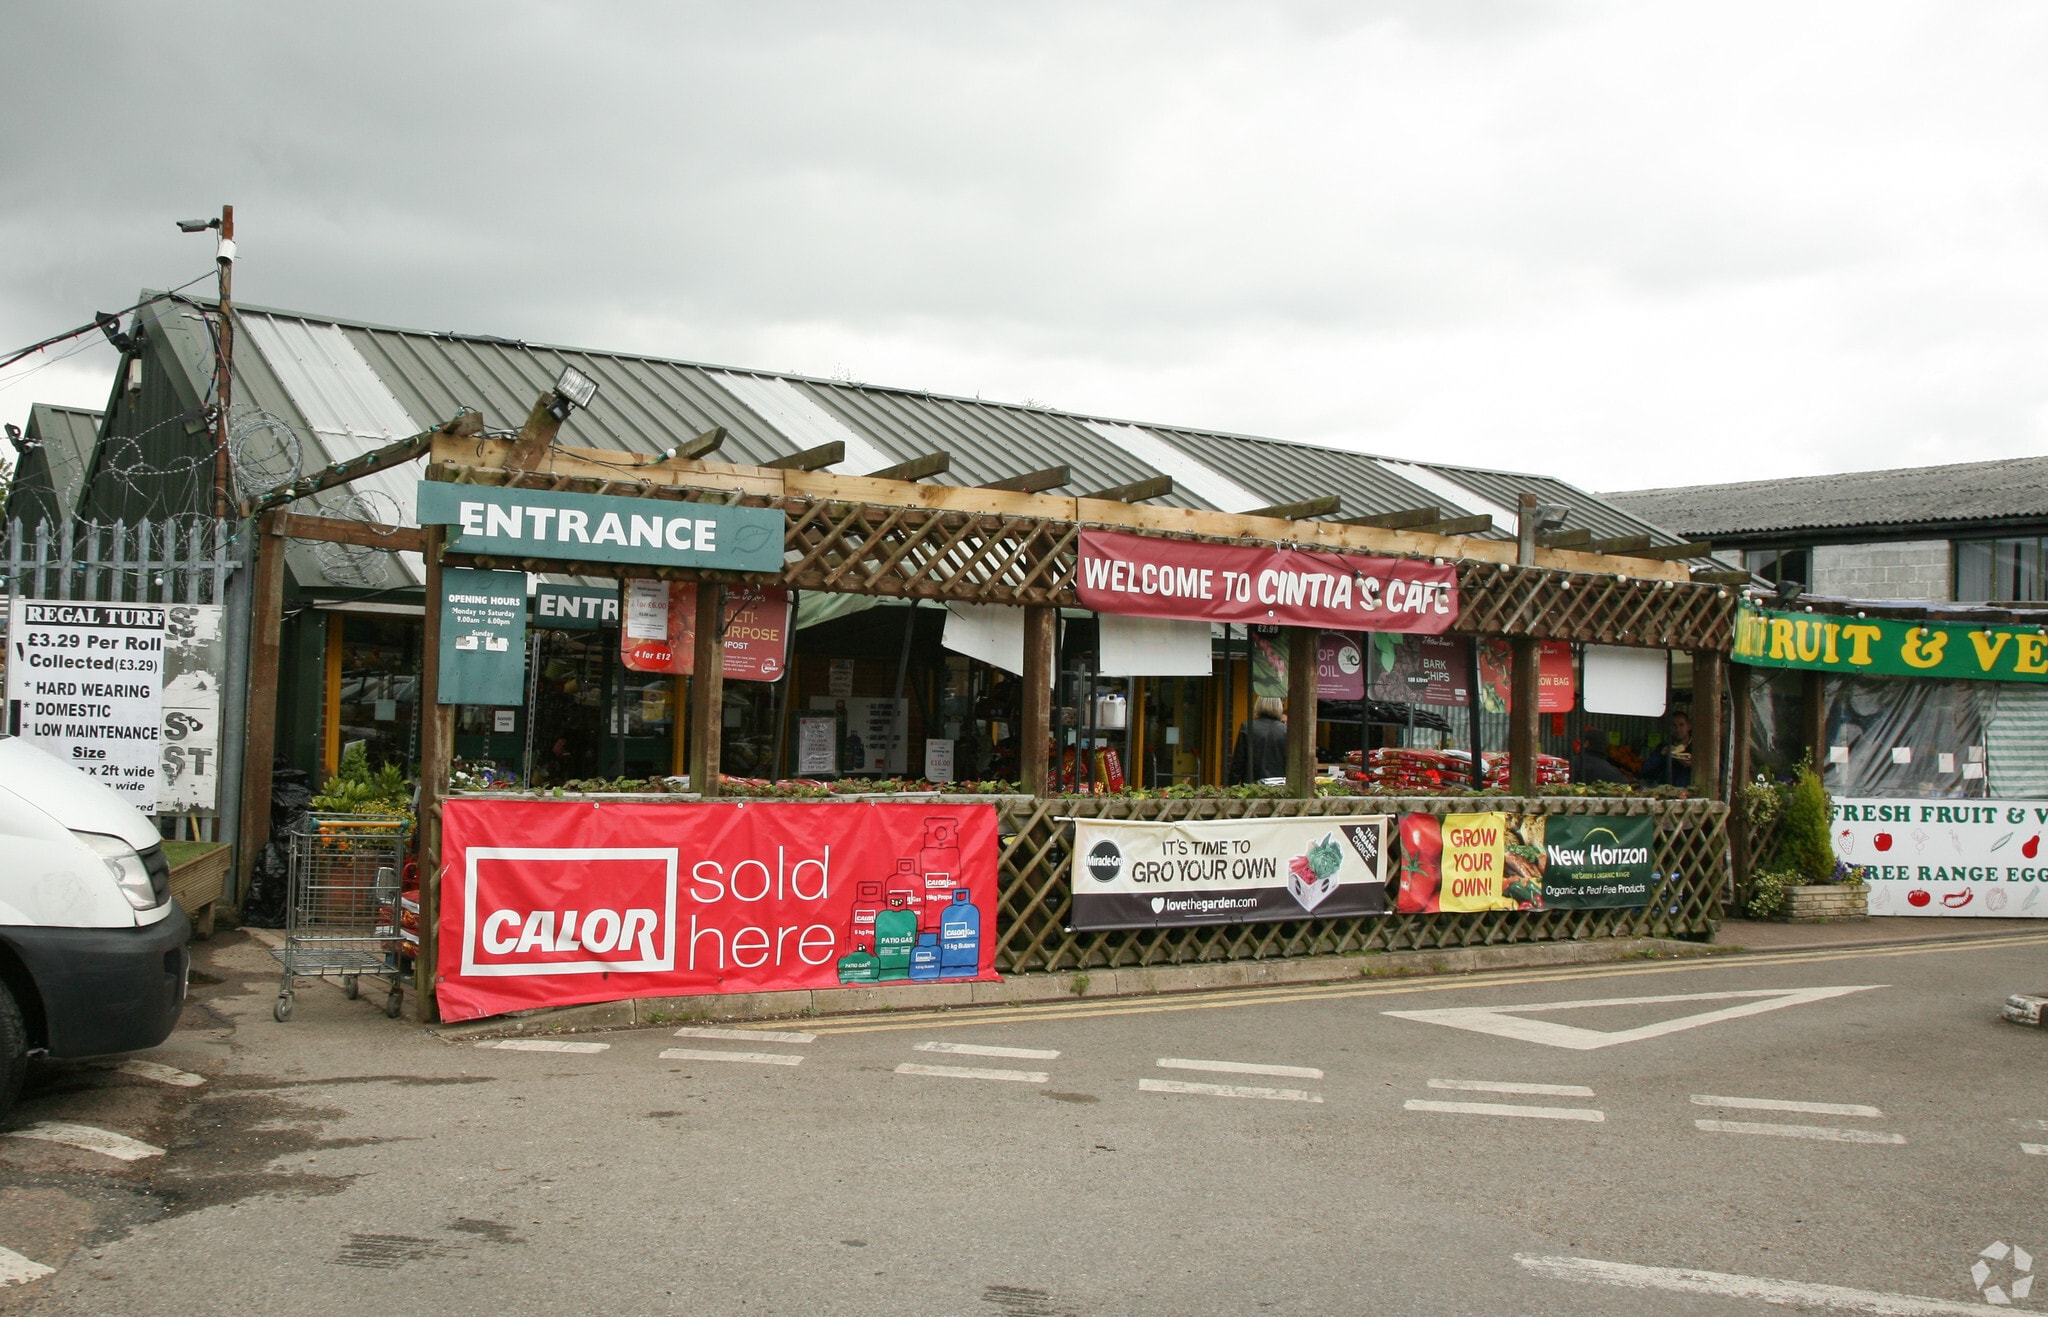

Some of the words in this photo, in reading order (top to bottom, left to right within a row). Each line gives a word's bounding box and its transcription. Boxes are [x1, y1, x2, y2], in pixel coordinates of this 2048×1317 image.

[459, 501, 717, 552] ENTRANCE
[1083, 556, 1214, 600] WELCOME
[1222, 570, 1251, 603] TO
[1257, 569, 1380, 611] CINTIAS
[1386, 578, 1452, 614] CAFE
[448, 594, 488, 604] OPENING
[490, 596, 520, 606] HOURS
[539, 594, 618, 622] ENTR
[26, 606, 101, 625] REGAL
[105, 608, 165, 627] TURF
[451, 607, 477, 616] Monday
[487, 609, 515, 618] Saturday
[725, 610, 758, 624] ULTI-
[487, 618, 511, 626] 6.00pm
[1257, 625, 1279, 633] £2.99
[28, 632, 80, 649] £3.29
[87, 635, 119, 650] Per
[125, 636, 162, 651] Roll
[471, 629, 494, 638] Sunday
[724, 625, 779, 642] URPOSE
[1736, 609, 1882, 666] RUIT
[1900, 626, 1949, 669] &
[1967, 631, 2048, 674] VE
[724, 641, 749, 650] MPOST
[642, 651, 654, 659] for
[655, 652, 671, 661] £12
[1318, 649, 1335, 661] OP
[1318, 664, 1339, 677] OIL
[1423, 658, 1447, 670] BARK
[36, 681, 76, 697] HARD
[82, 682, 150, 699] WEARING
[1553, 677, 1569, 686] BAG
[35, 702, 111, 718] DOMESTIC
[35, 723, 62, 738] LOW
[65, 724, 158, 741] MAINTENANCE
[72, 746, 106, 760] Size
[89, 767, 97, 776] x
[101, 764, 120, 777] 2ft
[123, 765, 155, 778] wide
[115, 781, 146, 791] wide
[1831, 805, 1911, 823] FRESH
[1920, 806, 1998, 824] FRUIT
[2006, 807, 2026, 825] &
[1355, 826, 1378, 857] ORGANIC
[1365, 827, 1378, 844] THE
[1450, 828, 1497, 848] GROW
[1162, 838, 1188, 856] IT'S
[1191, 840, 1228, 856] TIME
[1232, 840, 1251, 854] TO
[1352, 835, 1372, 862] CHOICE
[1547, 845, 1585, 866] New
[1590, 844, 1648, 865] Horizon
[1131, 861, 1174, 883] GRO
[1178, 859, 1228, 881] YOUR
[1232, 857, 1277, 879] OWN
[1453, 852, 1493, 873] YOUR
[690, 845, 830, 904] sold
[1865, 865, 1910, 881] REE
[1917, 866, 1999, 882] RANGE
[927, 879, 948, 887] CALOR
[1452, 877, 1492, 897] OWN!
[1545, 885, 1577, 897] Organic
[1577, 886, 1585, 895] &
[1586, 885, 1602, 895] Peat
[1602, 884, 1617, 894] Free
[1617, 883, 1646, 893] Products
[1166, 896, 1257, 914] lovethegarden.com
[482, 909, 664, 962] CALOR
[689, 913, 836, 970] here
[946, 929, 966, 937] CALOR
